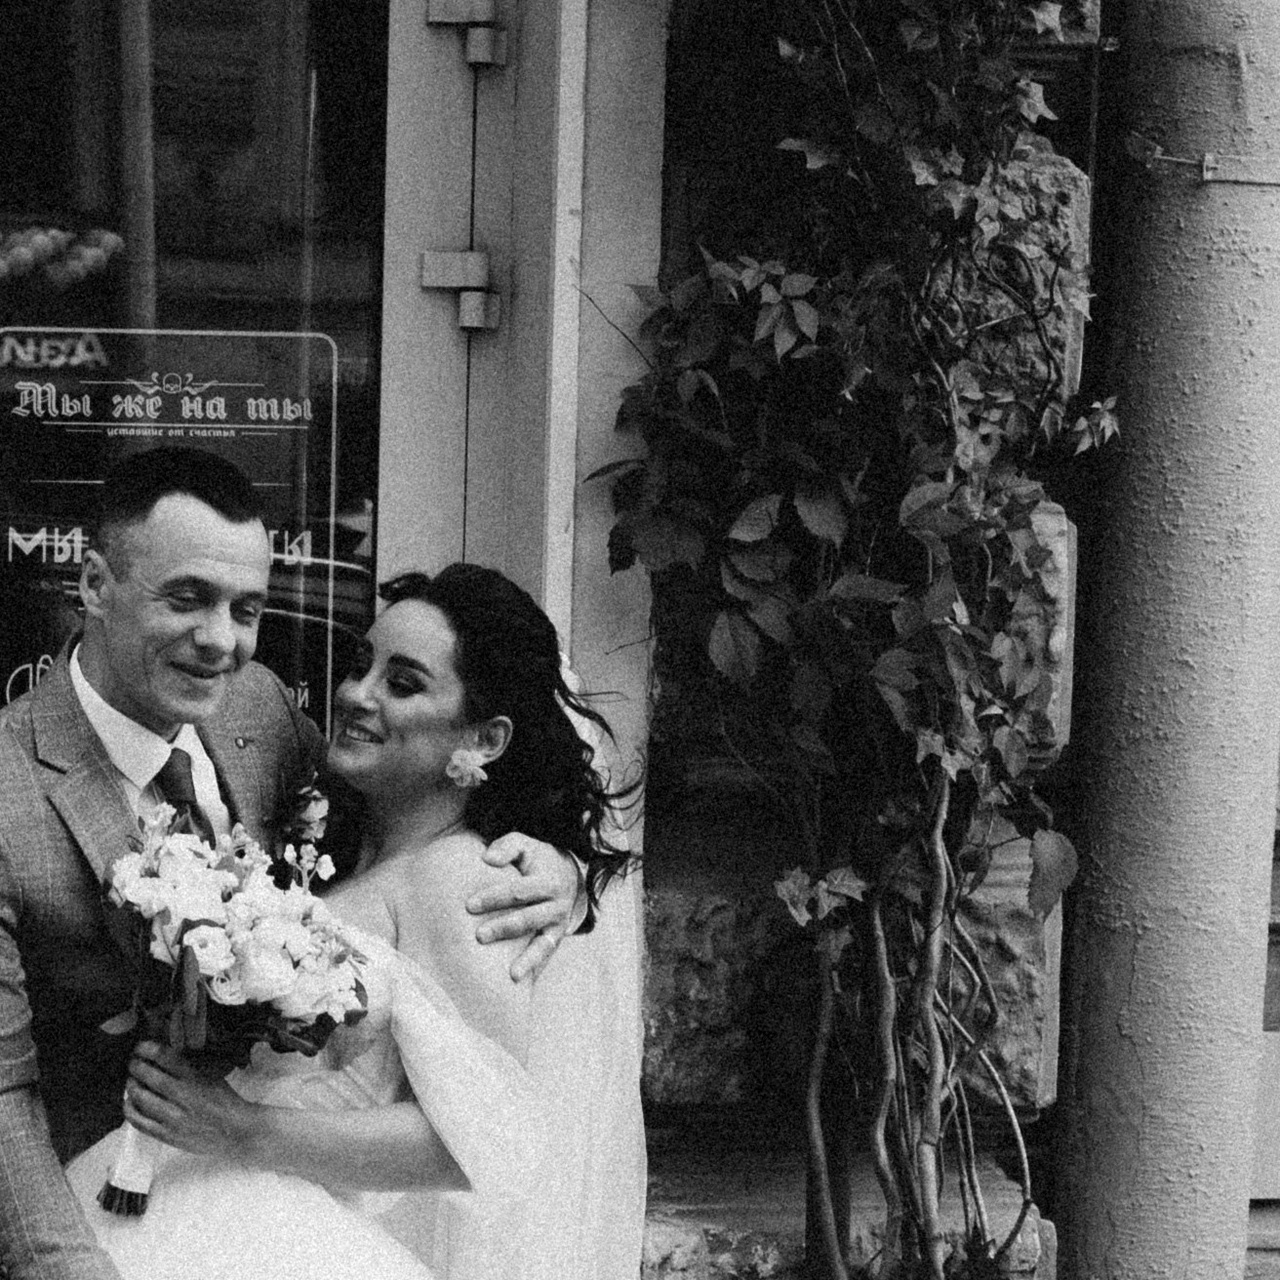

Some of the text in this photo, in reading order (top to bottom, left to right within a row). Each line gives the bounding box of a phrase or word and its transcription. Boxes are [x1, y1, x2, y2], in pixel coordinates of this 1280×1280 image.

[11, 380, 314, 422] Мы же на ты
